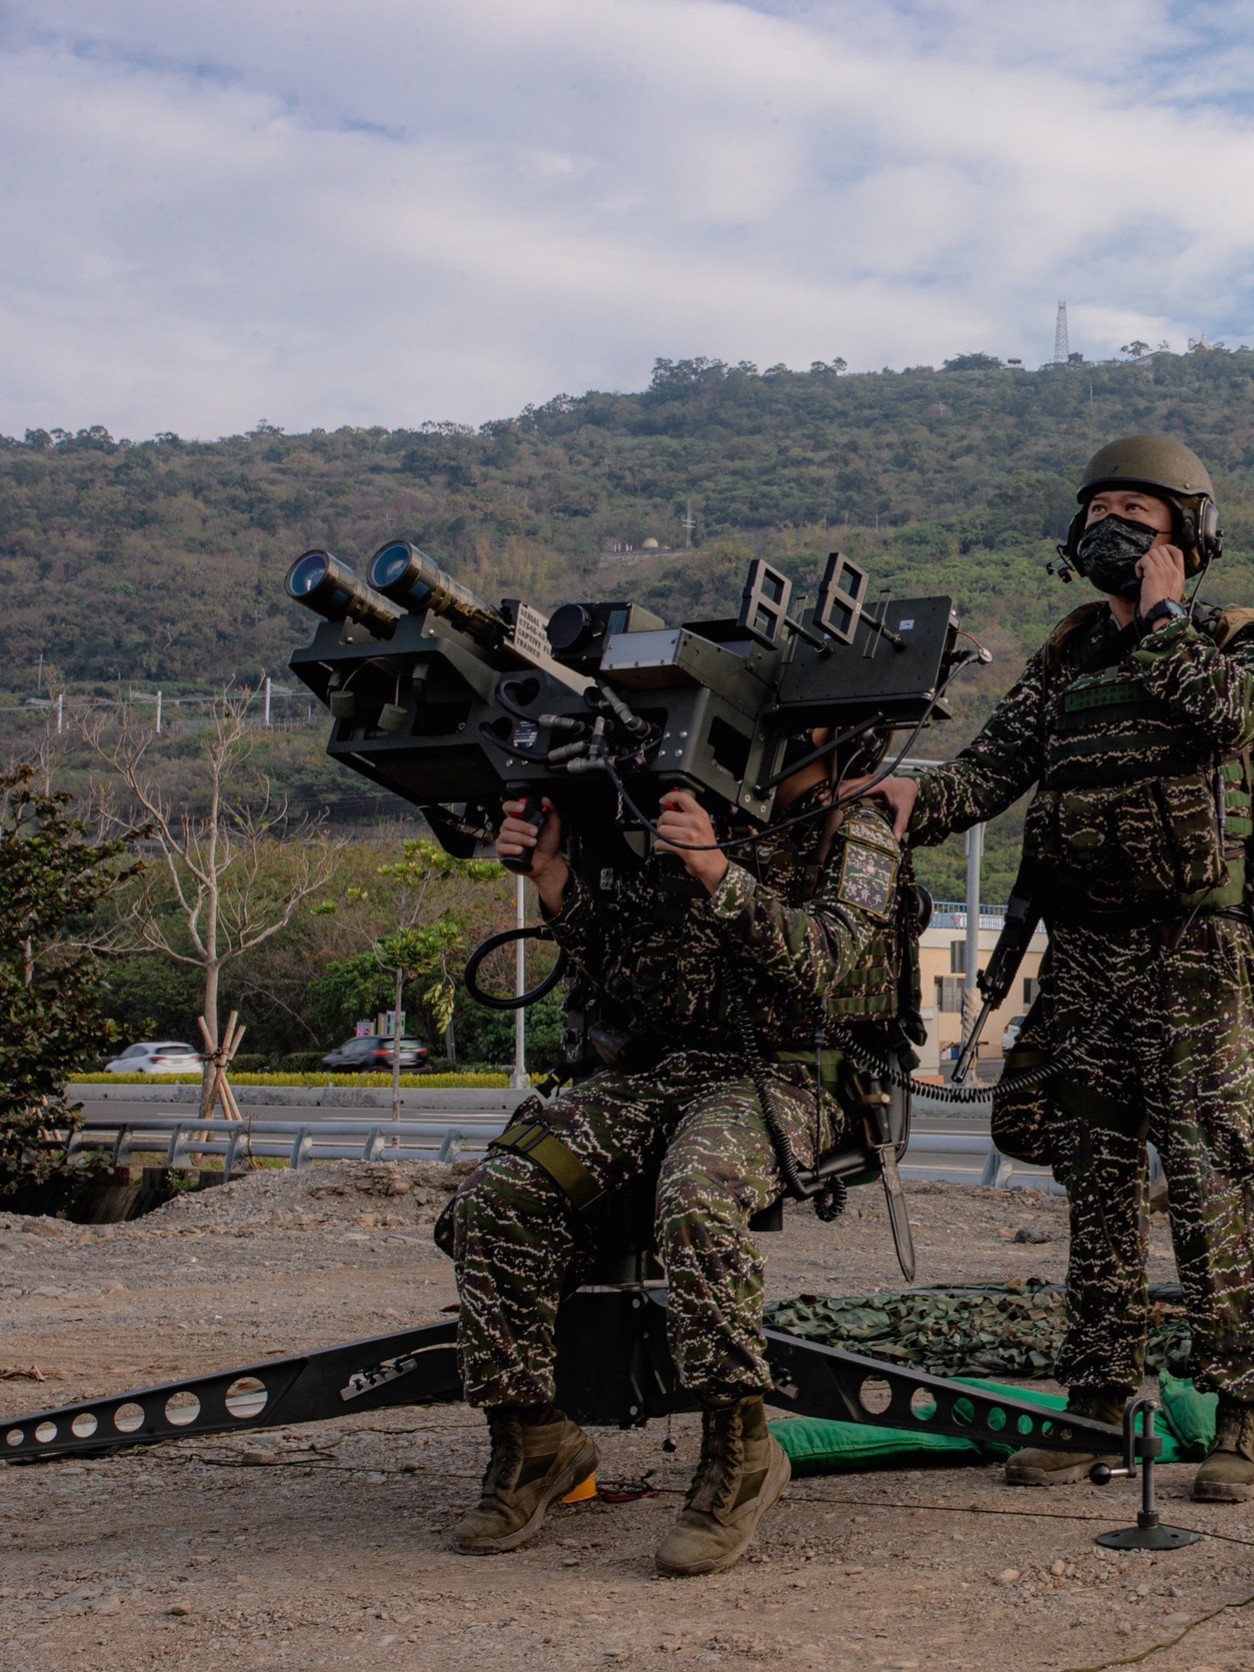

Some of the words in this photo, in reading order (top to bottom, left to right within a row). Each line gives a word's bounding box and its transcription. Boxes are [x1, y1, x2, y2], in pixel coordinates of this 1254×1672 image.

[521, 608, 540, 627] SERIAL
[517, 628, 541, 649] CAPTIVE
[543, 645, 551, 656] FL
[517, 638, 541, 658] TRAINER
